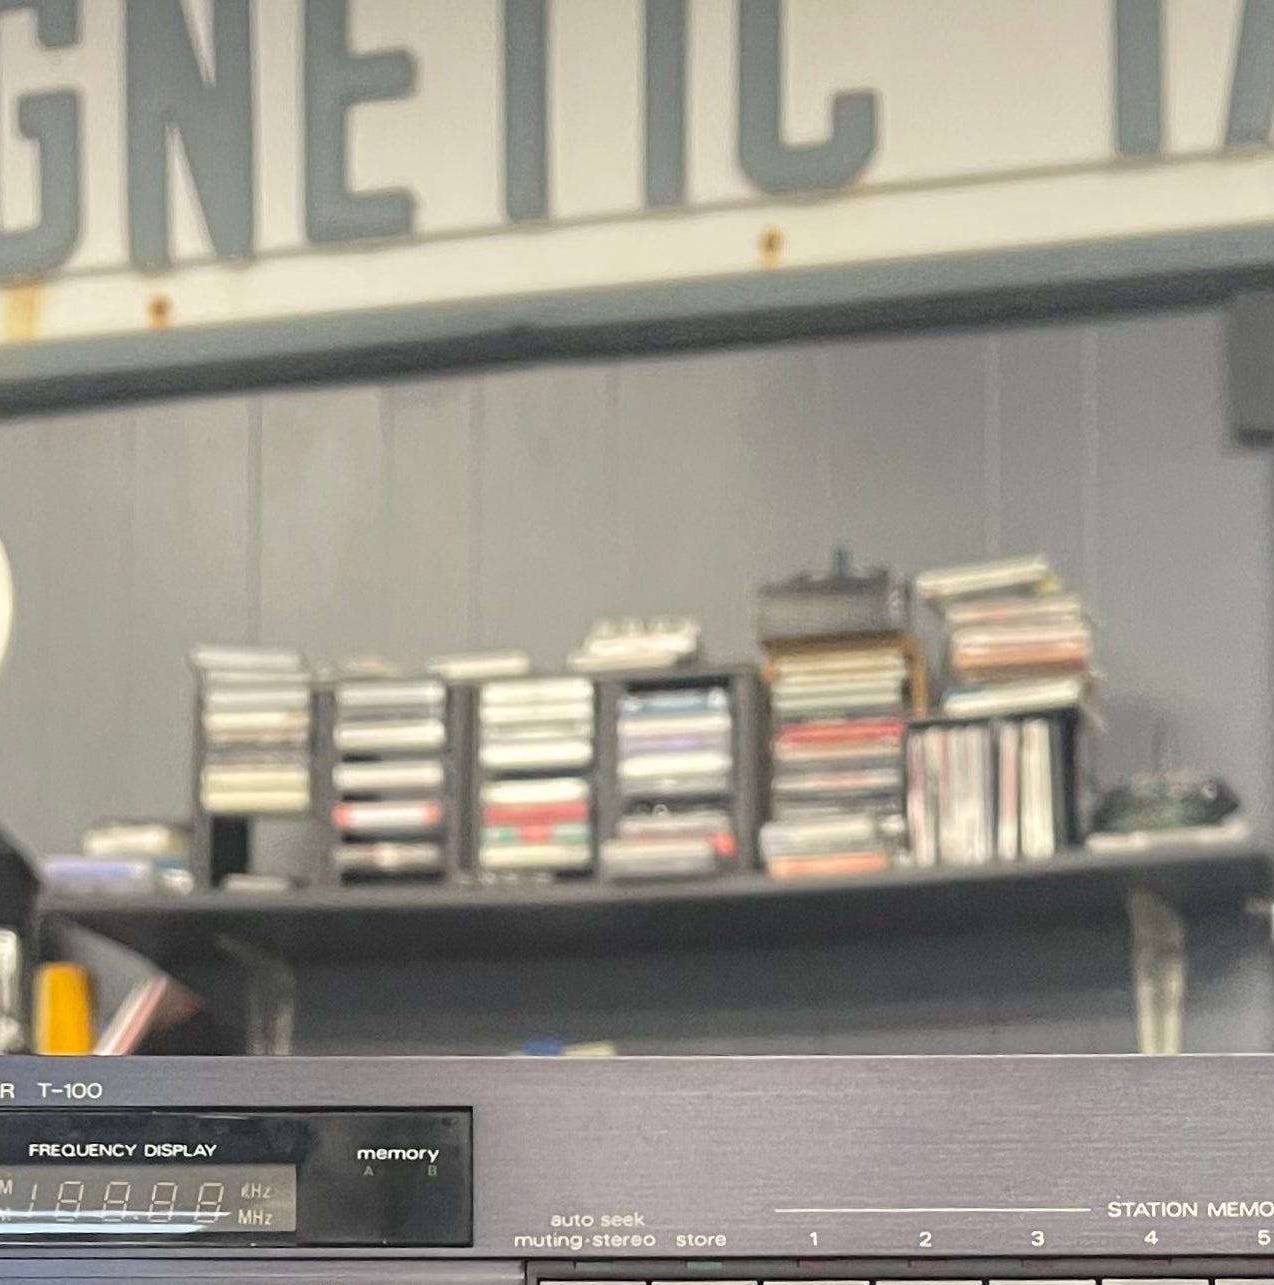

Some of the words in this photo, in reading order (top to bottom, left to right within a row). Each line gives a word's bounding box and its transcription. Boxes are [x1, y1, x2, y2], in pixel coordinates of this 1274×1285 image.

[37, 1083, 102, 1098] T-100
[29, 1144, 136, 1157] FREQUENCY
[145, 1144, 216, 1157] DISPLAY
[357, 1149, 439, 1162] memory
[238, 1209, 273, 1225] MHz
[1108, 1202, 1197, 1217] STATION
[551, 1215, 594, 1227] auto
[601, 1212, 645, 1227] seek
[677, 1234, 726, 1247] store
[810, 1232, 817, 1245] 1
[920, 1232, 931, 1247] 2
[1031, 1231, 1044, 1246] 3
[1145, 1230, 1158, 1244] 4
[1258, 1230, 1270, 1245] 5
